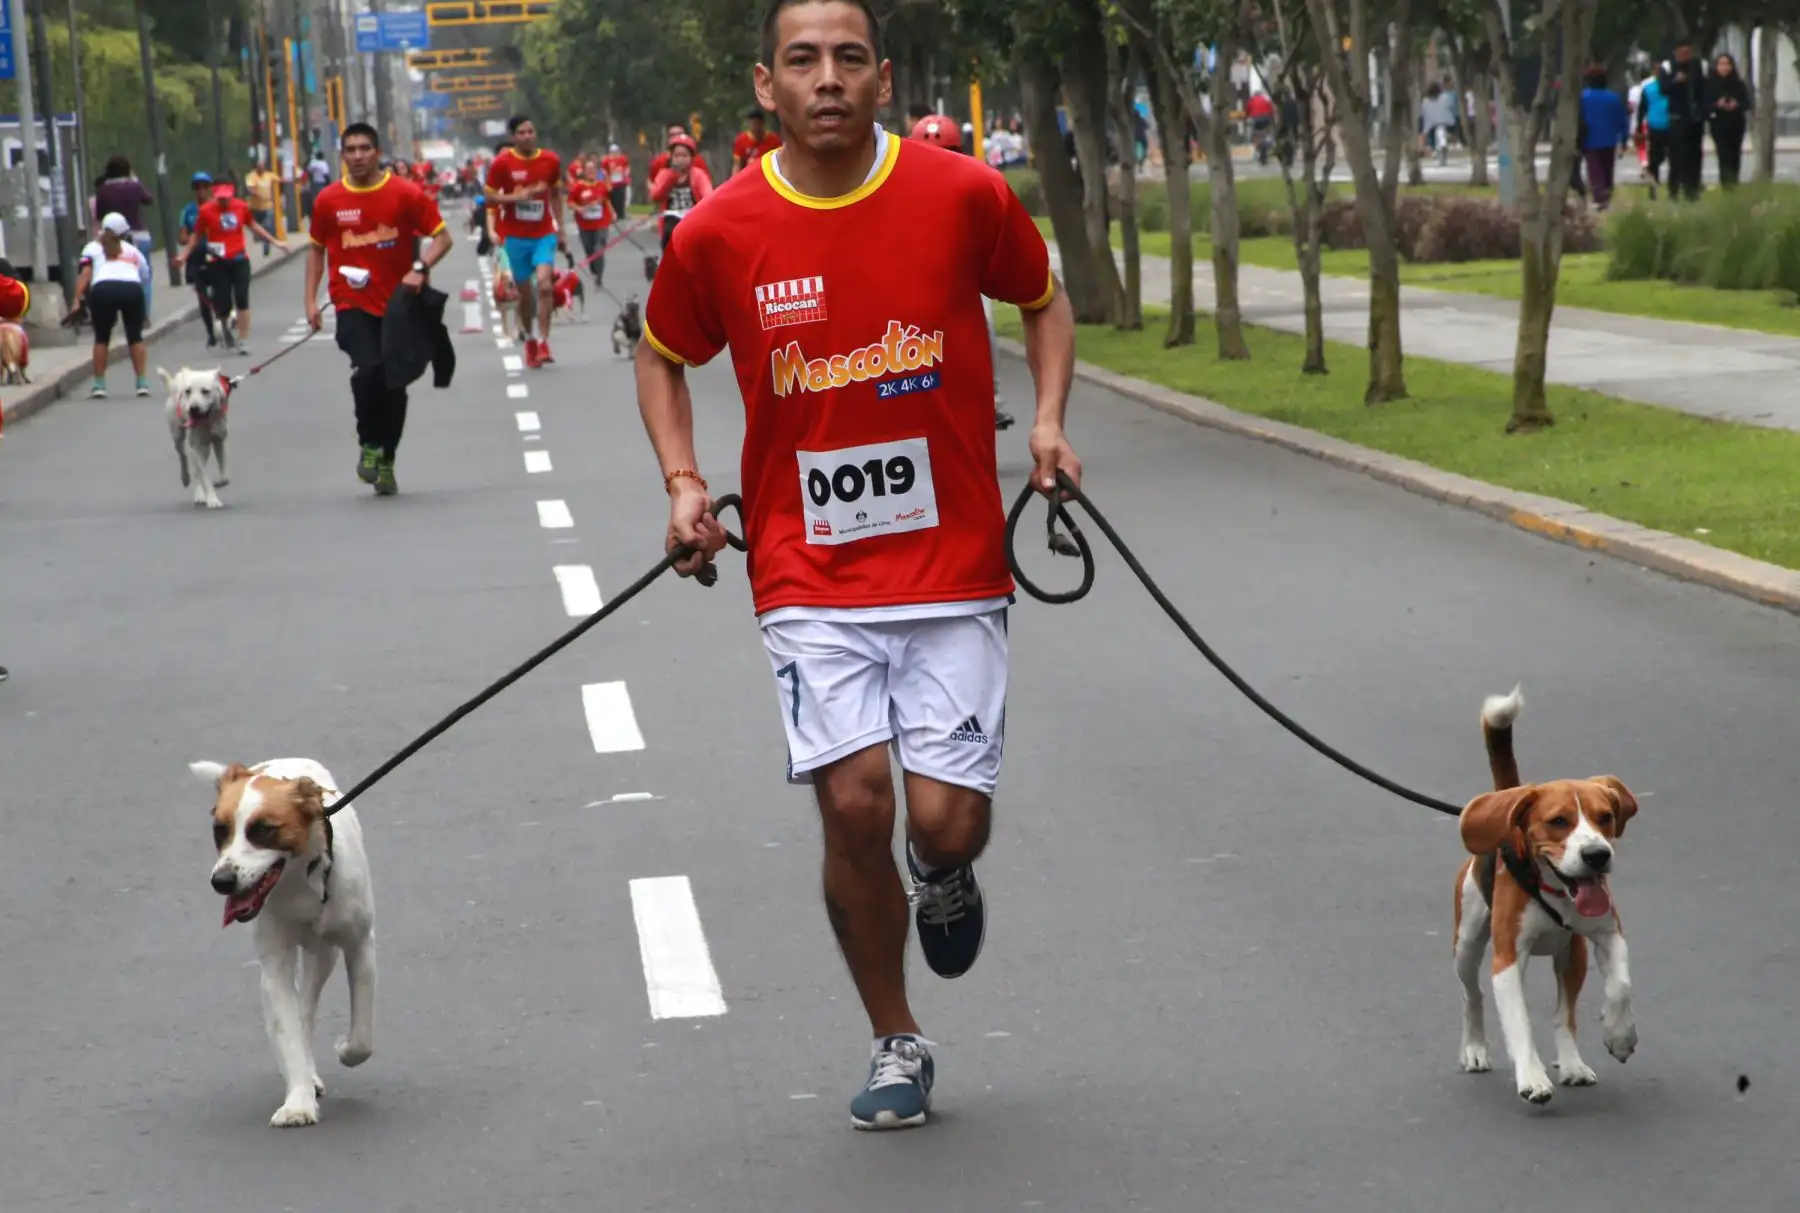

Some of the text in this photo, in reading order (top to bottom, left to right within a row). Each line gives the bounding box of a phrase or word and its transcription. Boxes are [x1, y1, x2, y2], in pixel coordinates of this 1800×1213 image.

[766, 298, 818, 315] Ricocan
[879, 381, 898, 397] 2K
[900, 377, 919, 392] 4K
[808, 456, 915, 506] 0019
[950, 731, 988, 744] adidas
